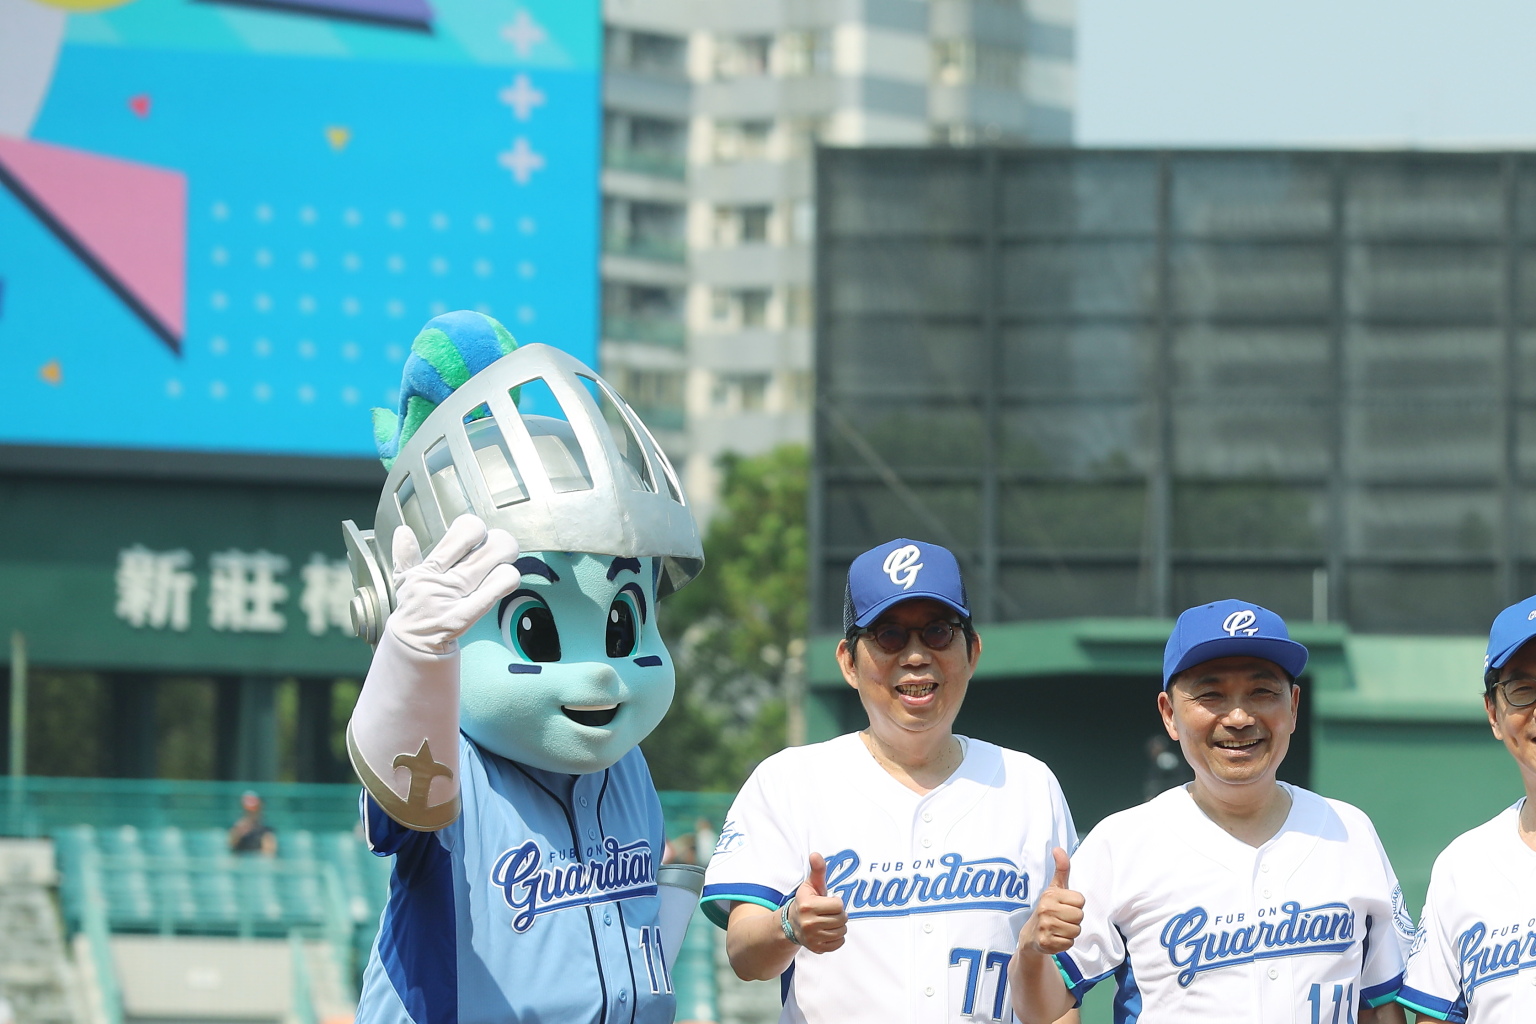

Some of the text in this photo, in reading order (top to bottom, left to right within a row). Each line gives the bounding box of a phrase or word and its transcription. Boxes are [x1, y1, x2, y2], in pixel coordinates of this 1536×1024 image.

[490, 836, 658, 933] Guardian
[823, 849, 1031, 920] Guardians
[949, 947, 1013, 1024] 77
[1160, 901, 1356, 988] Guardians
